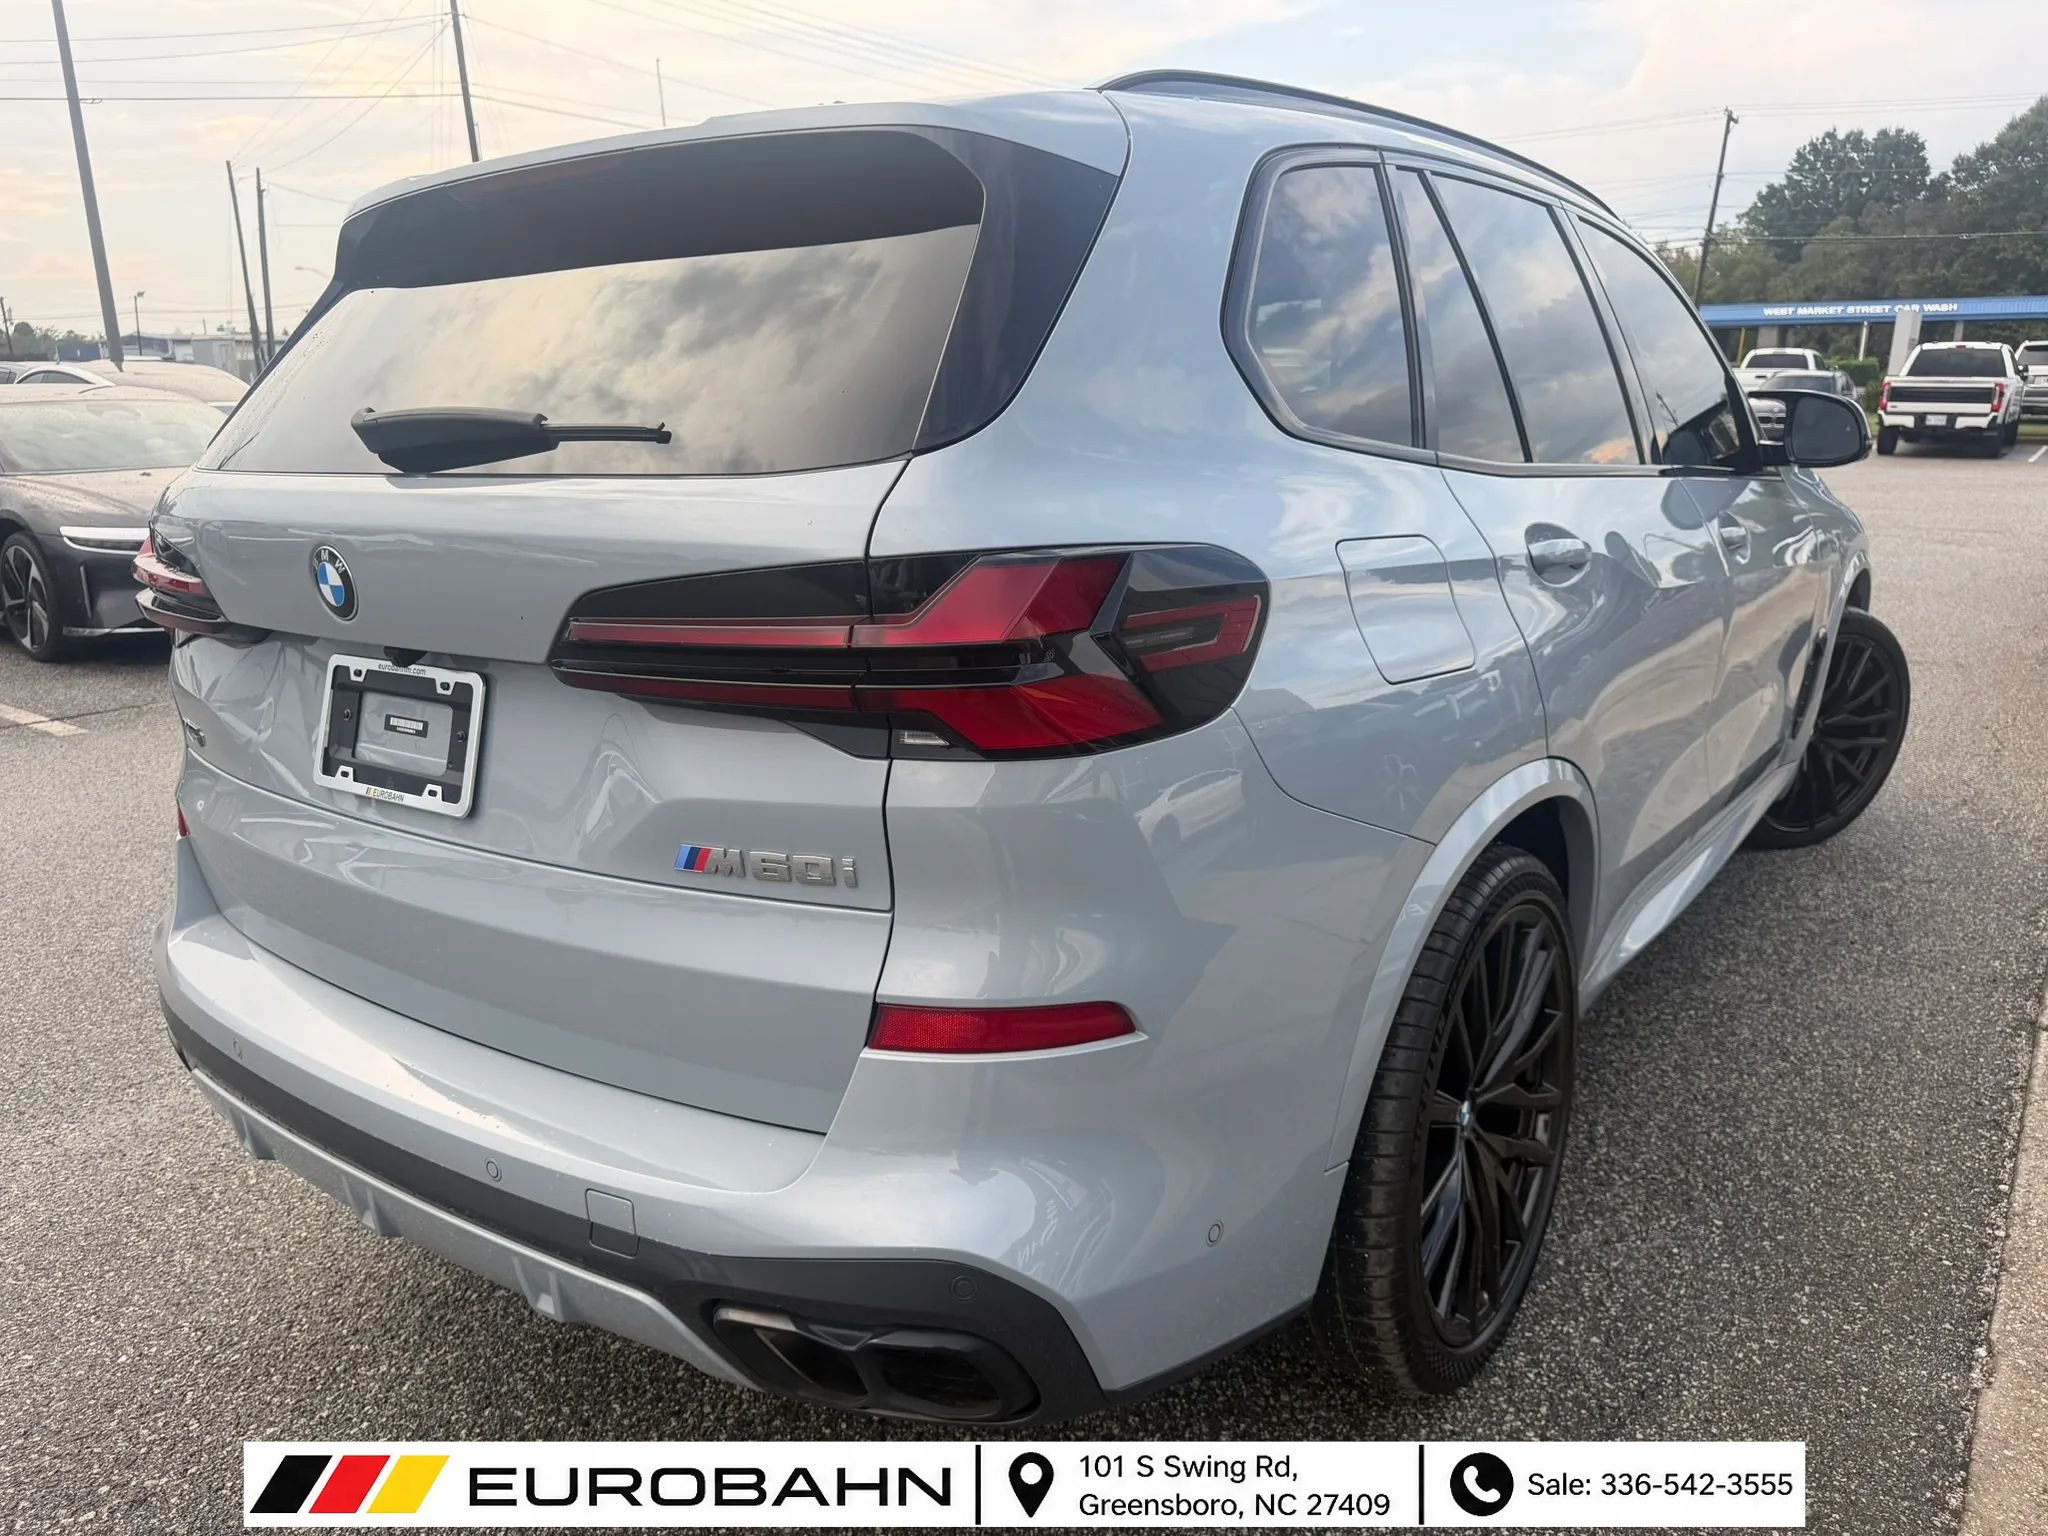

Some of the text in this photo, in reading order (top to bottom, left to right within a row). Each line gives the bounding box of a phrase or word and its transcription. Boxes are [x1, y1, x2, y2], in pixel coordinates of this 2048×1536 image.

[1763, 307, 1795, 316] WEST
[1797, 305, 1844, 316] MARKET
[1847, 304, 1892, 315] STREET
[1922, 303, 1958, 313] WASH
[312, 549, 346, 574] BMW
[373, 788, 405, 802] EUROBAHN
[702, 846, 858, 889] M60i
